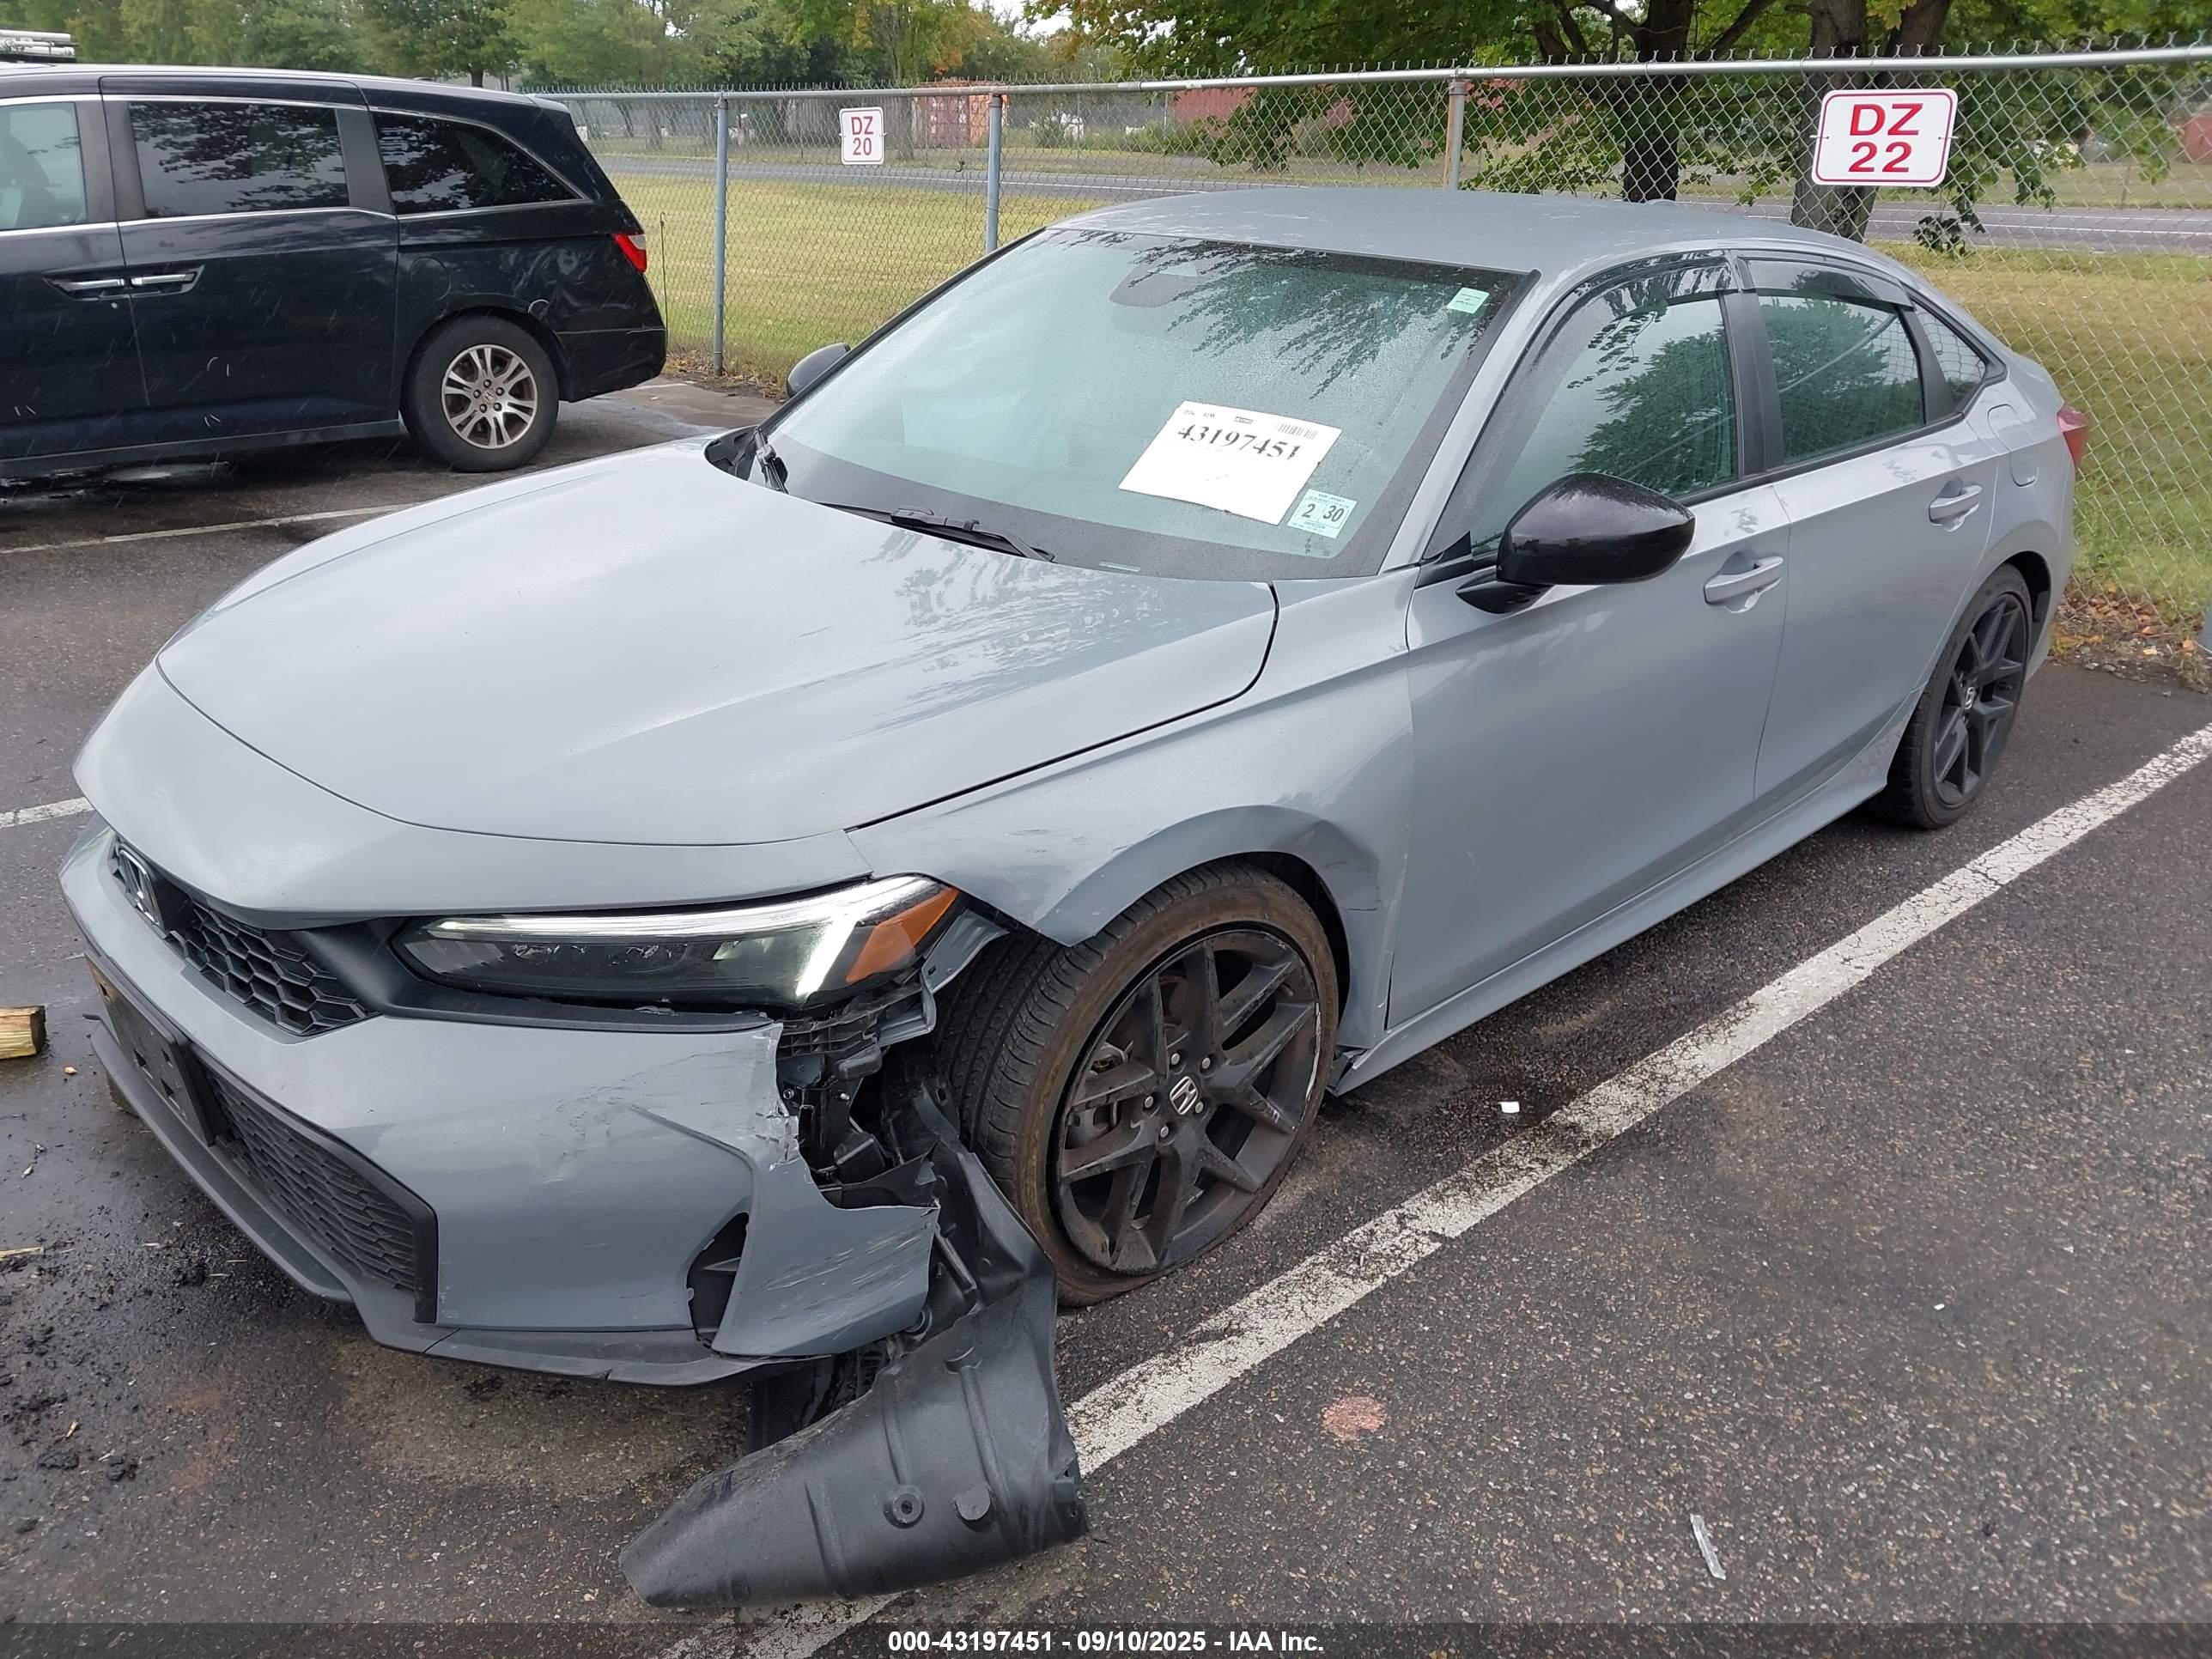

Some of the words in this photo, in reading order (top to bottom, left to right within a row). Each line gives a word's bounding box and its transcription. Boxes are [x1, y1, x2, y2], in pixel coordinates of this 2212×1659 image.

[851, 116, 874, 135] DZ
[1850, 103, 1923, 136] DZ
[853, 137, 872, 155] 20
[1848, 141, 1912, 173] 22
[1177, 424, 1302, 460] 43197451
[1301, 503, 1316, 519] 2
[1322, 505, 1345, 522] 30
